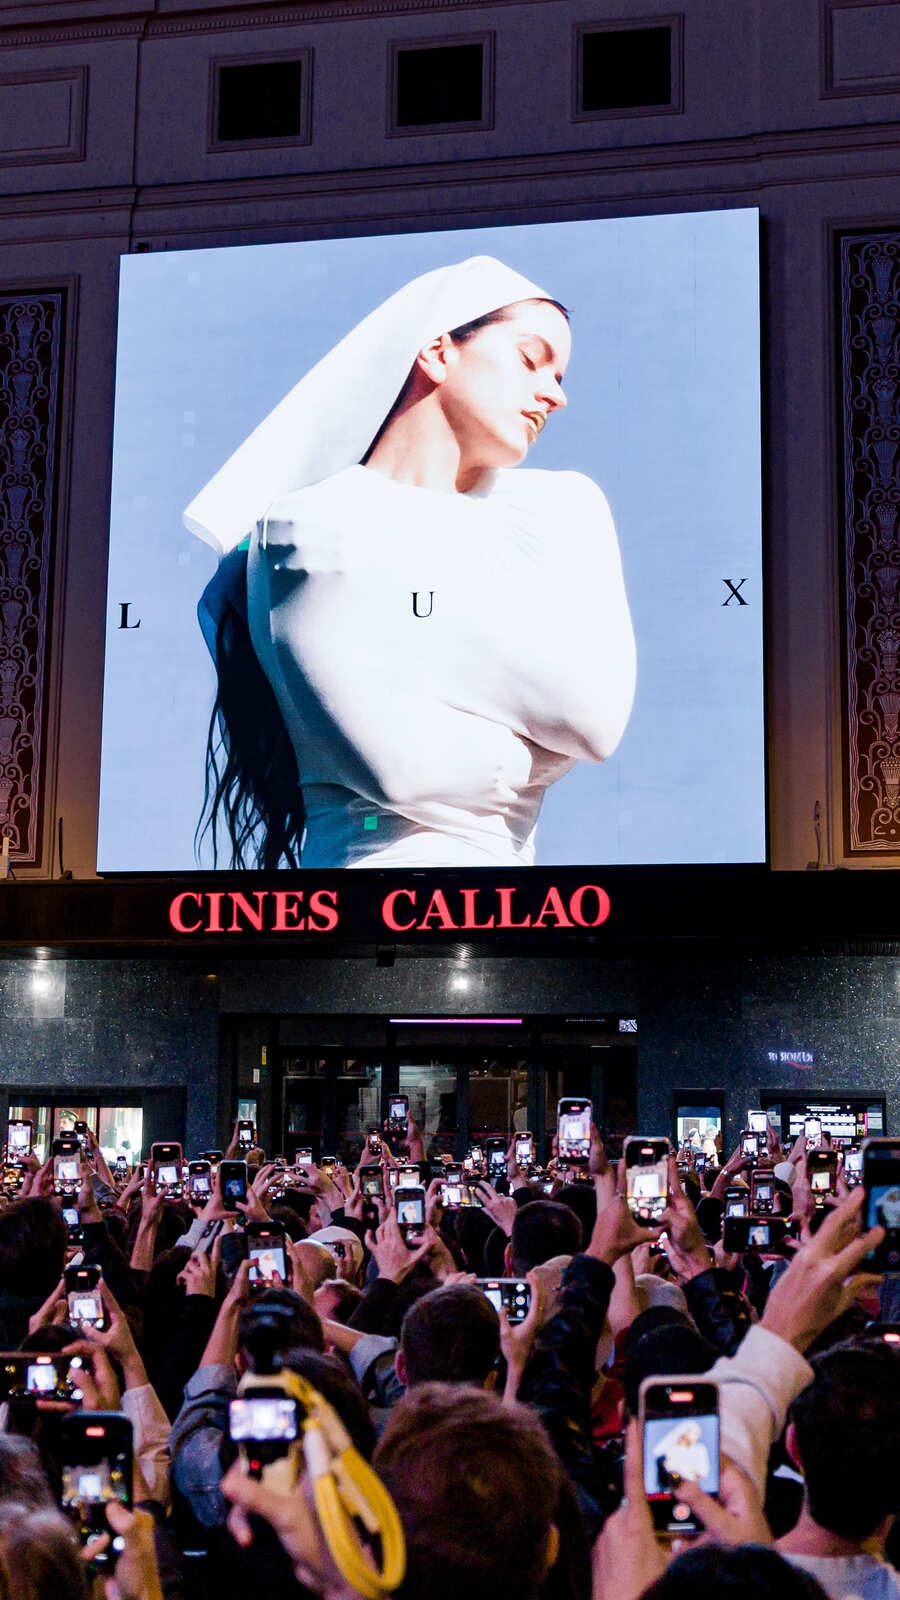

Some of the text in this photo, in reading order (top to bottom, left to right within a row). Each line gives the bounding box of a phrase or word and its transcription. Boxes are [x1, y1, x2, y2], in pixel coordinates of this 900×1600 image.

[118, 578, 749, 630] L U X
[168, 884, 611, 934] CINES CALLAO
